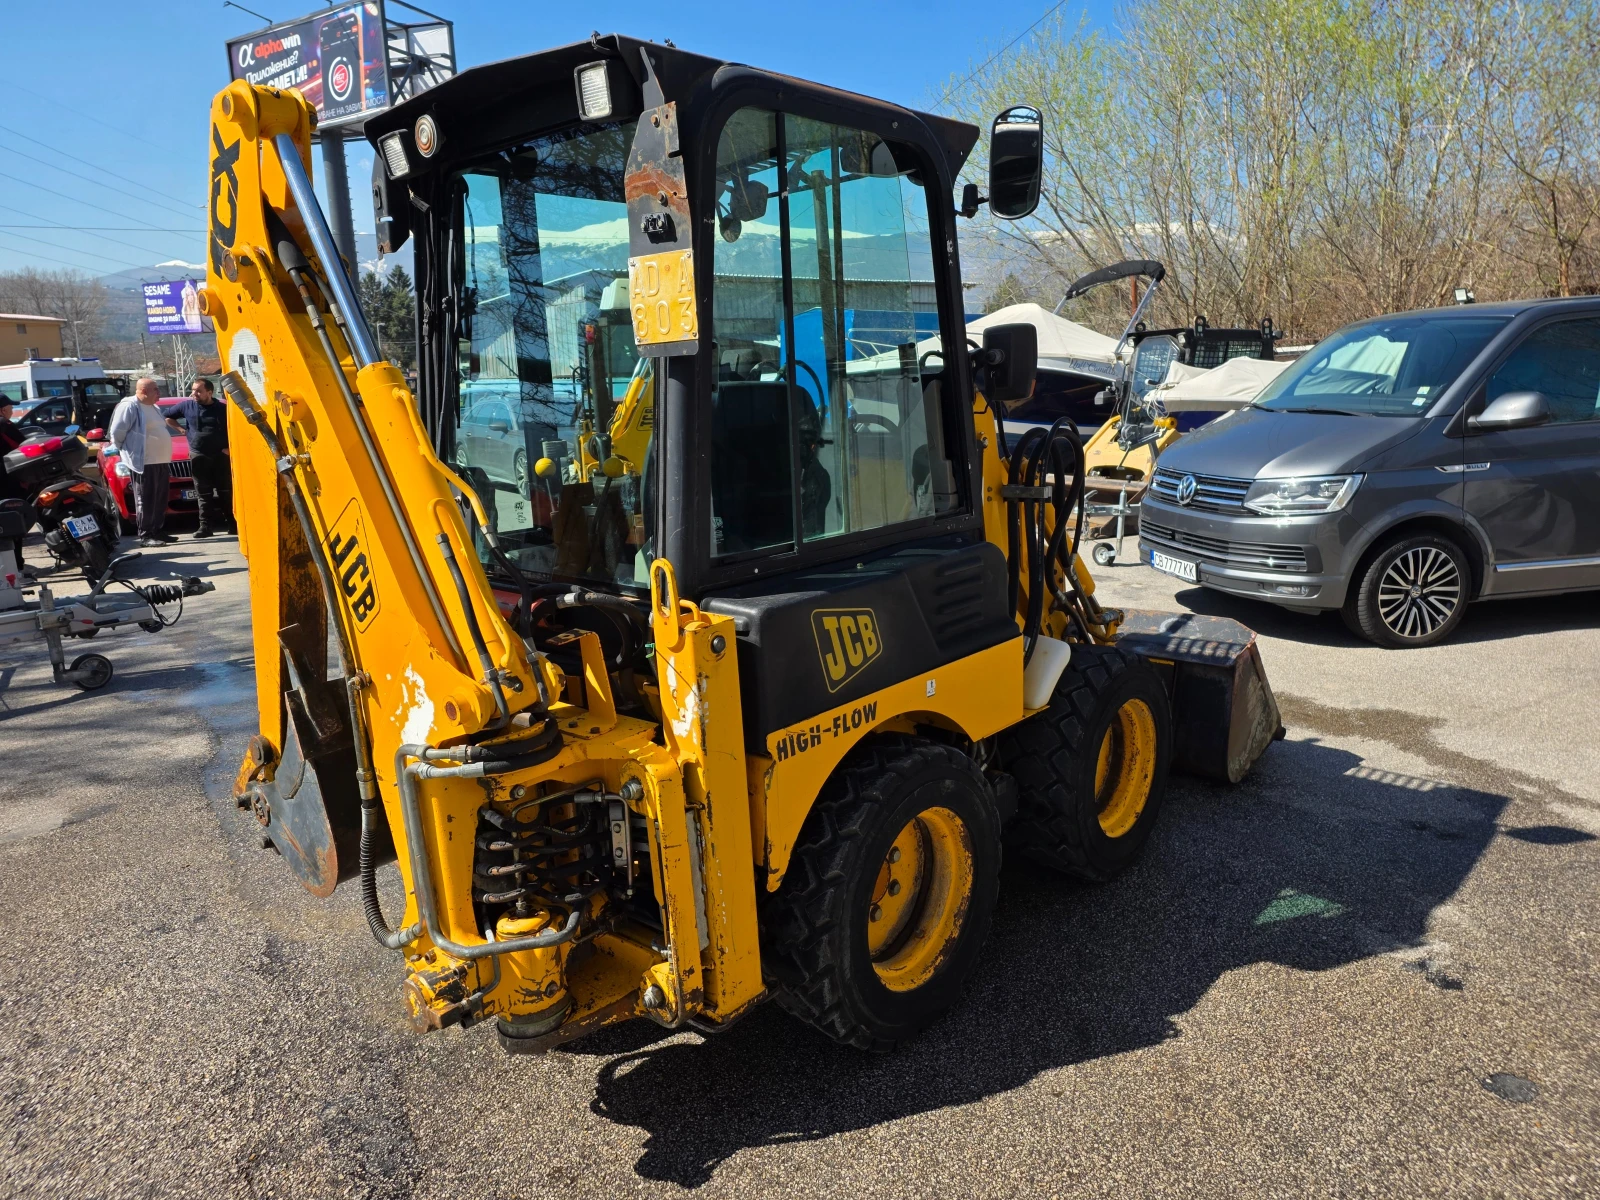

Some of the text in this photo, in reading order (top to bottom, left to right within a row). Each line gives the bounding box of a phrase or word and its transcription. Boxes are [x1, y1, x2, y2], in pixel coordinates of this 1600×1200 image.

[255, 34, 301, 58] alphawin
[336, 107, 345, 116] НА
[144, 284, 171, 296] SESAME
[634, 297, 695, 337] 803
[329, 532, 376, 622] JCB
[822, 615, 878, 681] JCB
[776, 701, 878, 762] HIGH-FLOW
